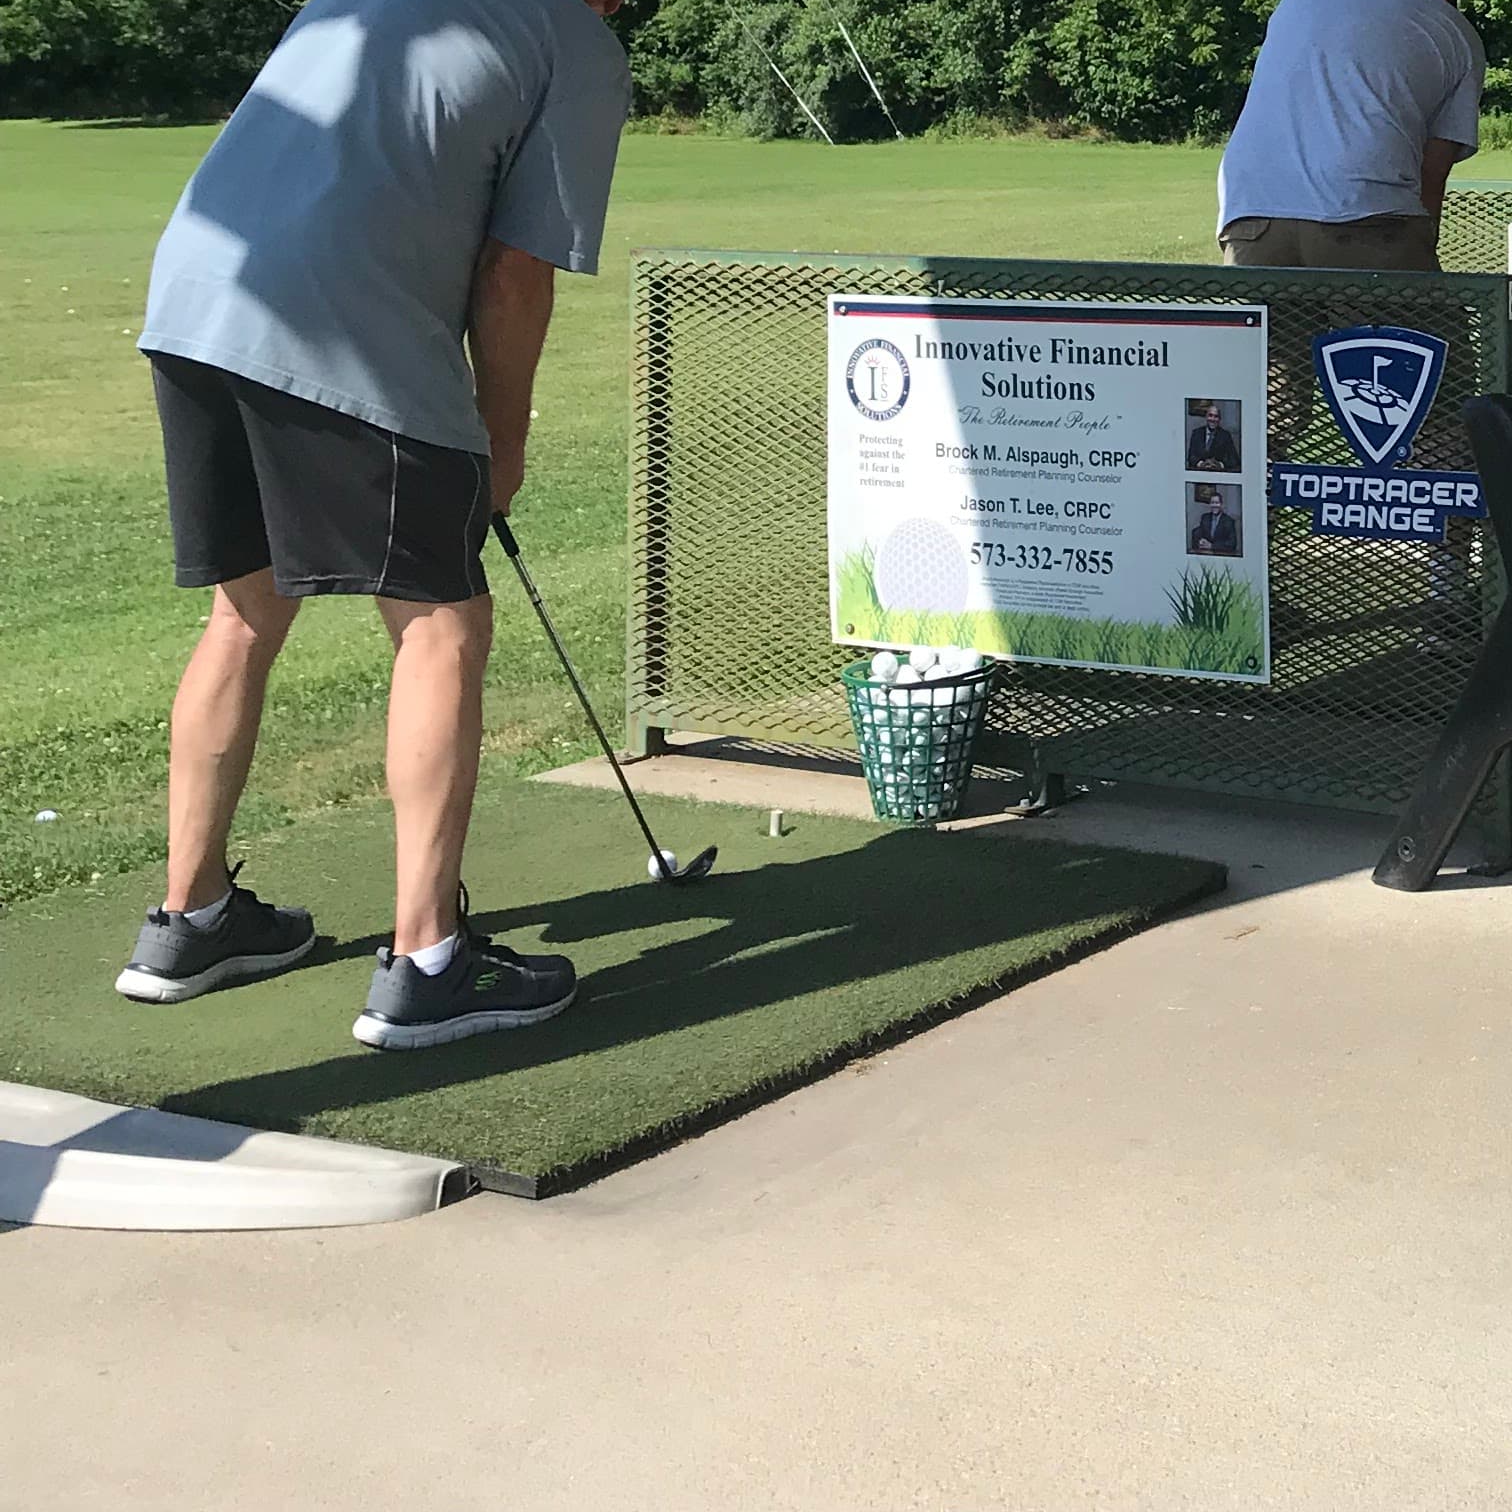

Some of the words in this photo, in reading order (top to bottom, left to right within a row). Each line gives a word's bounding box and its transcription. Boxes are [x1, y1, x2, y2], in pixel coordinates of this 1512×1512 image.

[914, 334, 1042, 363] Innovative
[1050, 337, 1169, 367] Financial
[981, 371, 1096, 402] Solutions
[987, 407, 1062, 429] Retirement
[859, 433, 904, 448] Protecting
[859, 449, 890, 460] against
[892, 450, 906, 460] the
[935, 442, 979, 460] Brock
[983, 444, 1002, 462] M.
[1005, 445, 1085, 469] Alspaugh,
[872, 462, 889, 473] fear
[891, 463, 900, 473] in
[949, 465, 990, 477] Chartered
[991, 467, 1037, 480] Retirement
[1038, 470, 1076, 484] Planning
[1077, 472, 1122, 484] Counselor
[859, 477, 905, 489] retirement
[1279, 473, 1479, 508] TOPTRACER
[960, 495, 1005, 513] Jason
[1009, 497, 1022, 514] T.
[1026, 498, 1060, 520] Lee,
[1321, 502, 1436, 533] RANGE
[950, 515, 990, 528] Chartered
[992, 517, 1038, 531] Retirement
[1039, 521, 1077, 535] Planning
[1078, 523, 1123, 536] Counselor
[970, 542, 1114, 575] 573-332-7855
